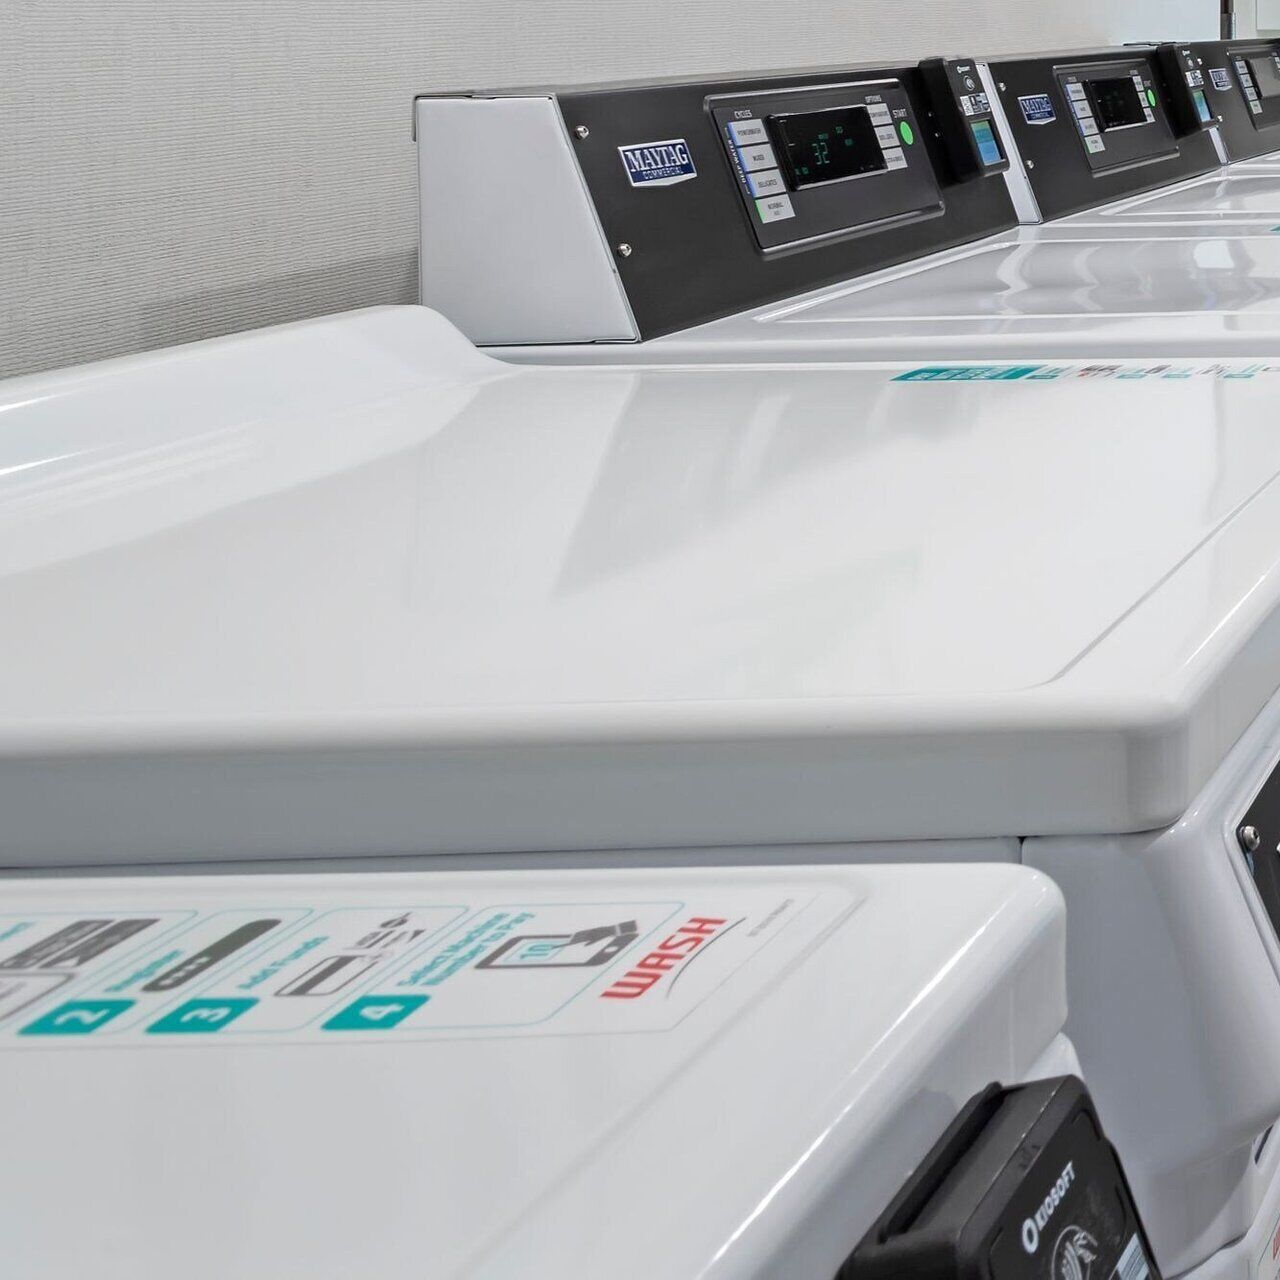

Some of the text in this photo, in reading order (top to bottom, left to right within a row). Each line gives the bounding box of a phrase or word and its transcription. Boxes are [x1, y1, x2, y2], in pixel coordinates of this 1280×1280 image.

[624, 144, 690, 172] MAYTAG
[812, 142, 830, 165] 32
[600, 917, 728, 999] WASH
[54, 1008, 110, 1025] 2
[180, 1007, 231, 1022] 3
[359, 1003, 406, 1020] 4
[1035, 1161, 1076, 1231] KIOSOFT
